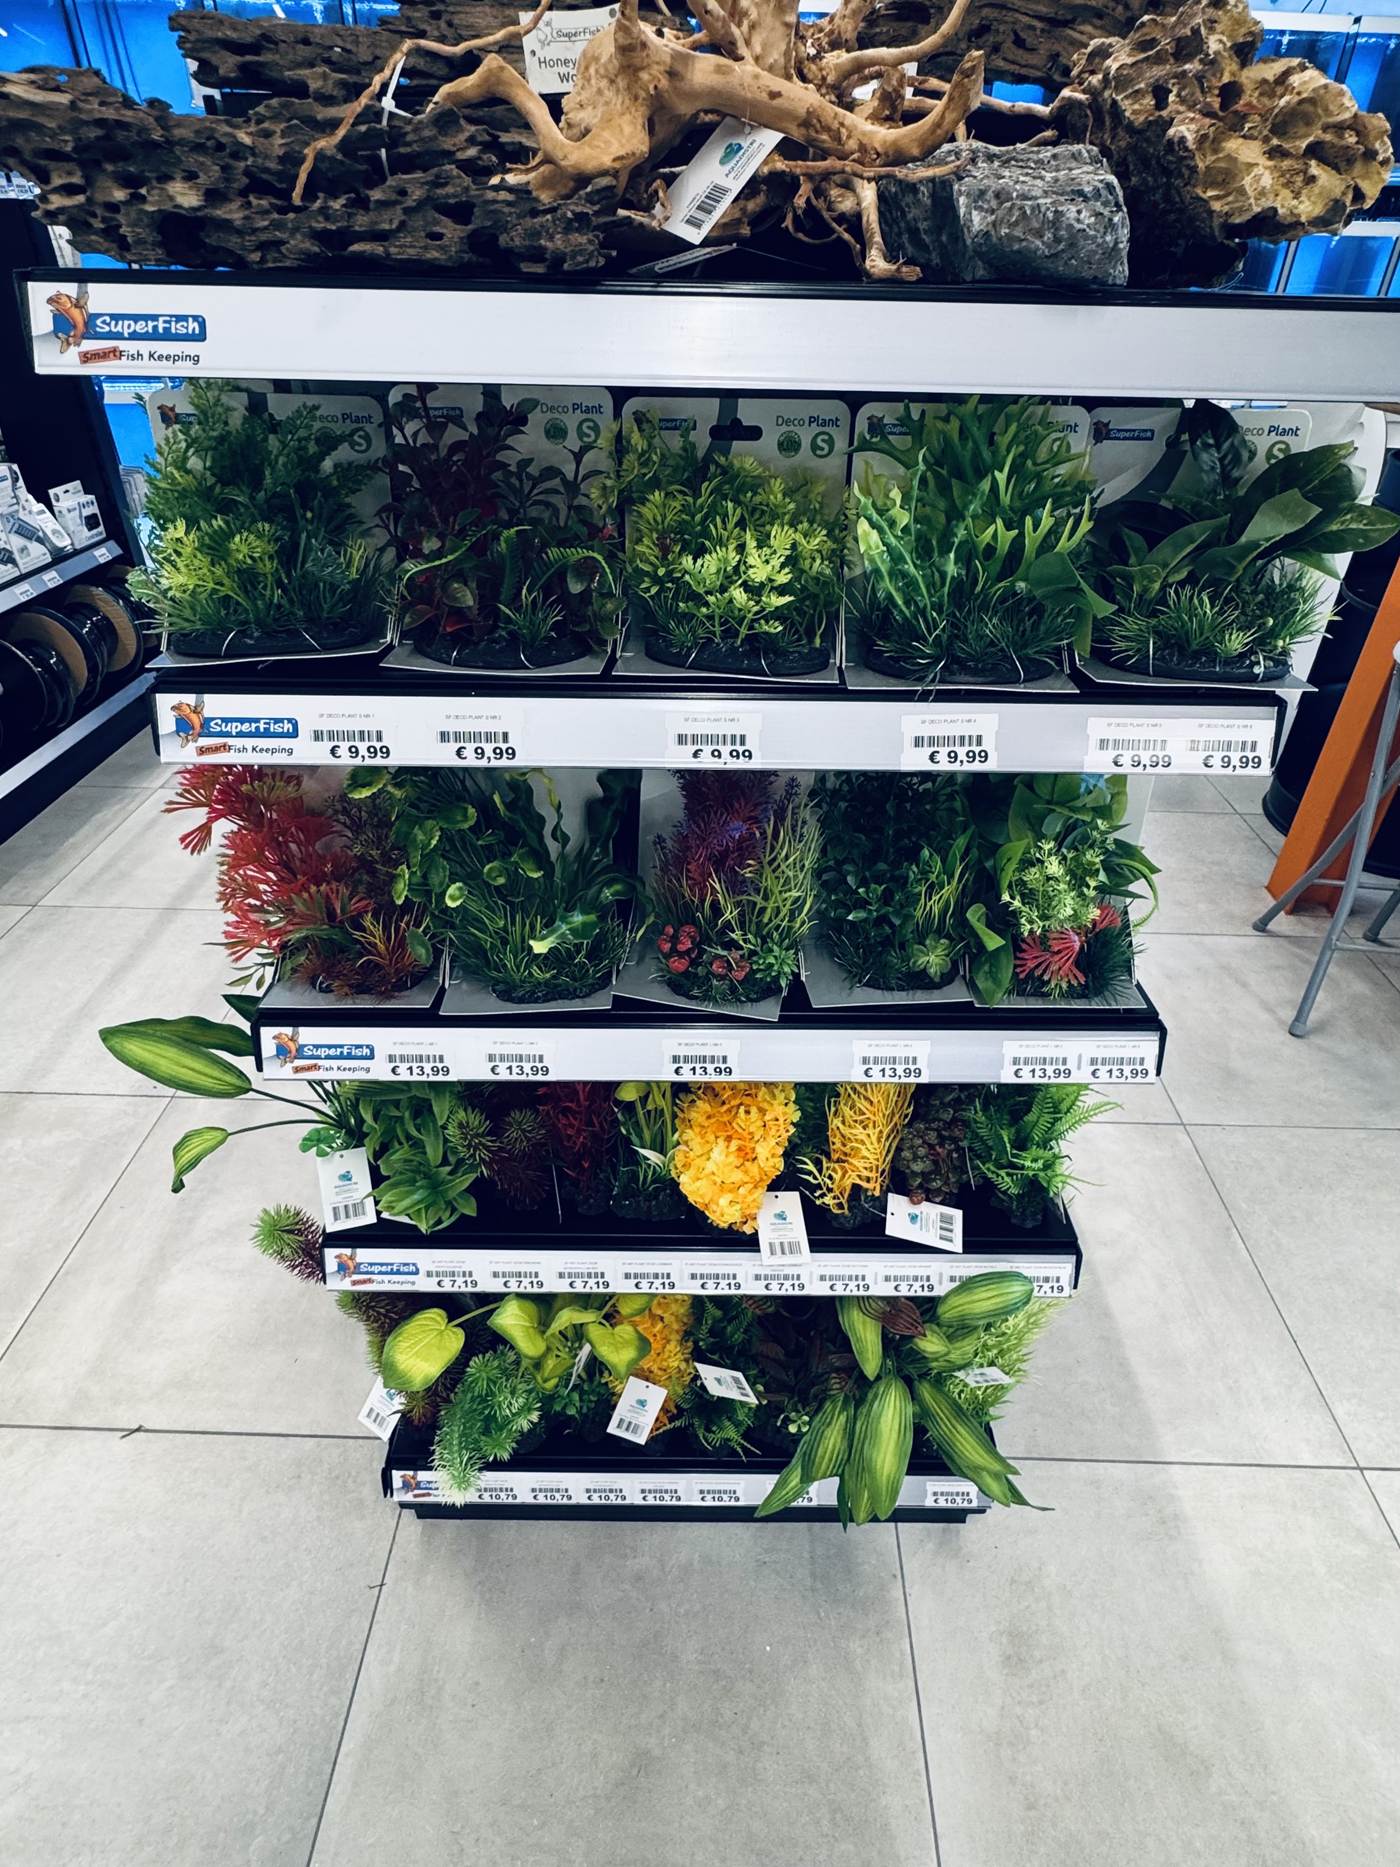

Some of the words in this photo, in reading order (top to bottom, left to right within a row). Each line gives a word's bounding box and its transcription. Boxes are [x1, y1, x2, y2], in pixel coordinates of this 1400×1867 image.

[538, 57, 577, 69] Honey
[96, 316, 200, 337] SuperFish
[82, 350, 118, 363] Smart
[119, 351, 144, 362] Fish
[149, 352, 200, 366] Keeping
[540, 402, 569, 414] Deco
[572, 402, 604, 414] Plant
[318, 413, 339, 424] eco
[342, 412, 374, 425] Plant
[775, 415, 806, 427] Deco
[808, 415, 841, 428] Plant
[582, 422, 595, 442] S
[1110, 430, 1152, 439] SuperFish
[1267, 424, 1301, 437] Plant
[354, 431, 367, 451] S
[816, 433, 829, 456] S
[209, 719, 293, 735] SuperFish
[200, 744, 228, 756] Smart
[229, 745, 248, 754] Fish
[251, 745, 294, 756] Keeping
[329, 745, 342, 759] €
[348, 745, 391, 762] 9,99
[455, 746, 468, 760] €
[474, 746, 516, 763] 9,99
[692, 749, 703, 759] €
[711, 748, 753, 765] 9,99
[928, 750, 940, 764] €
[947, 749, 989, 766] 9,99
[1112, 754, 1124, 768] €
[1130, 754, 1172, 771] 9,99
[1202, 755, 1214, 769] €
[1220, 755, 1262, 772] 9,99
[303, 1045, 370, 1058] SuperFish
[318, 1065, 334, 1073] Fish
[336, 1065, 371, 1074] Keeping
[391, 1065, 401, 1076] €
[406, 1065, 450, 1079] 13,99
[490, 1065, 500, 1076] €
[505, 1065, 550, 1078] 13,99
[674, 1066, 684, 1076] €
[689, 1066, 733, 1079] 13,99
[864, 1067, 873, 1078] €
[878, 1067, 922, 1080] 13,99
[1013, 1068, 1023, 1079] €
[1029, 1068, 1072, 1080] 13,99
[1091, 1068, 1100, 1079] €
[1106, 1068, 1149, 1080] 13,99
[360, 1263, 416, 1273] SuperFish
[436, 1280, 445, 1288] €
[449, 1280, 478, 1289] 7,19
[503, 1280, 512, 1289] €
[515, 1280, 544, 1290] 7,19
[569, 1280, 577, 1289] €
[581, 1280, 610, 1290] 7,19
[764, 1282, 773, 1291] €
[776, 1282, 805, 1292] 7,19
[829, 1283, 838, 1292] €
[841, 1283, 870, 1293] 7,19
[893, 1284, 902, 1293] €
[906, 1284, 935, 1294] 7,19
[1036, 1284, 1064, 1295] 7,19
[488, 1493, 518, 1501] 10,79
[543, 1494, 573, 1502] 10,79
[597, 1494, 627, 1502] 10,79
